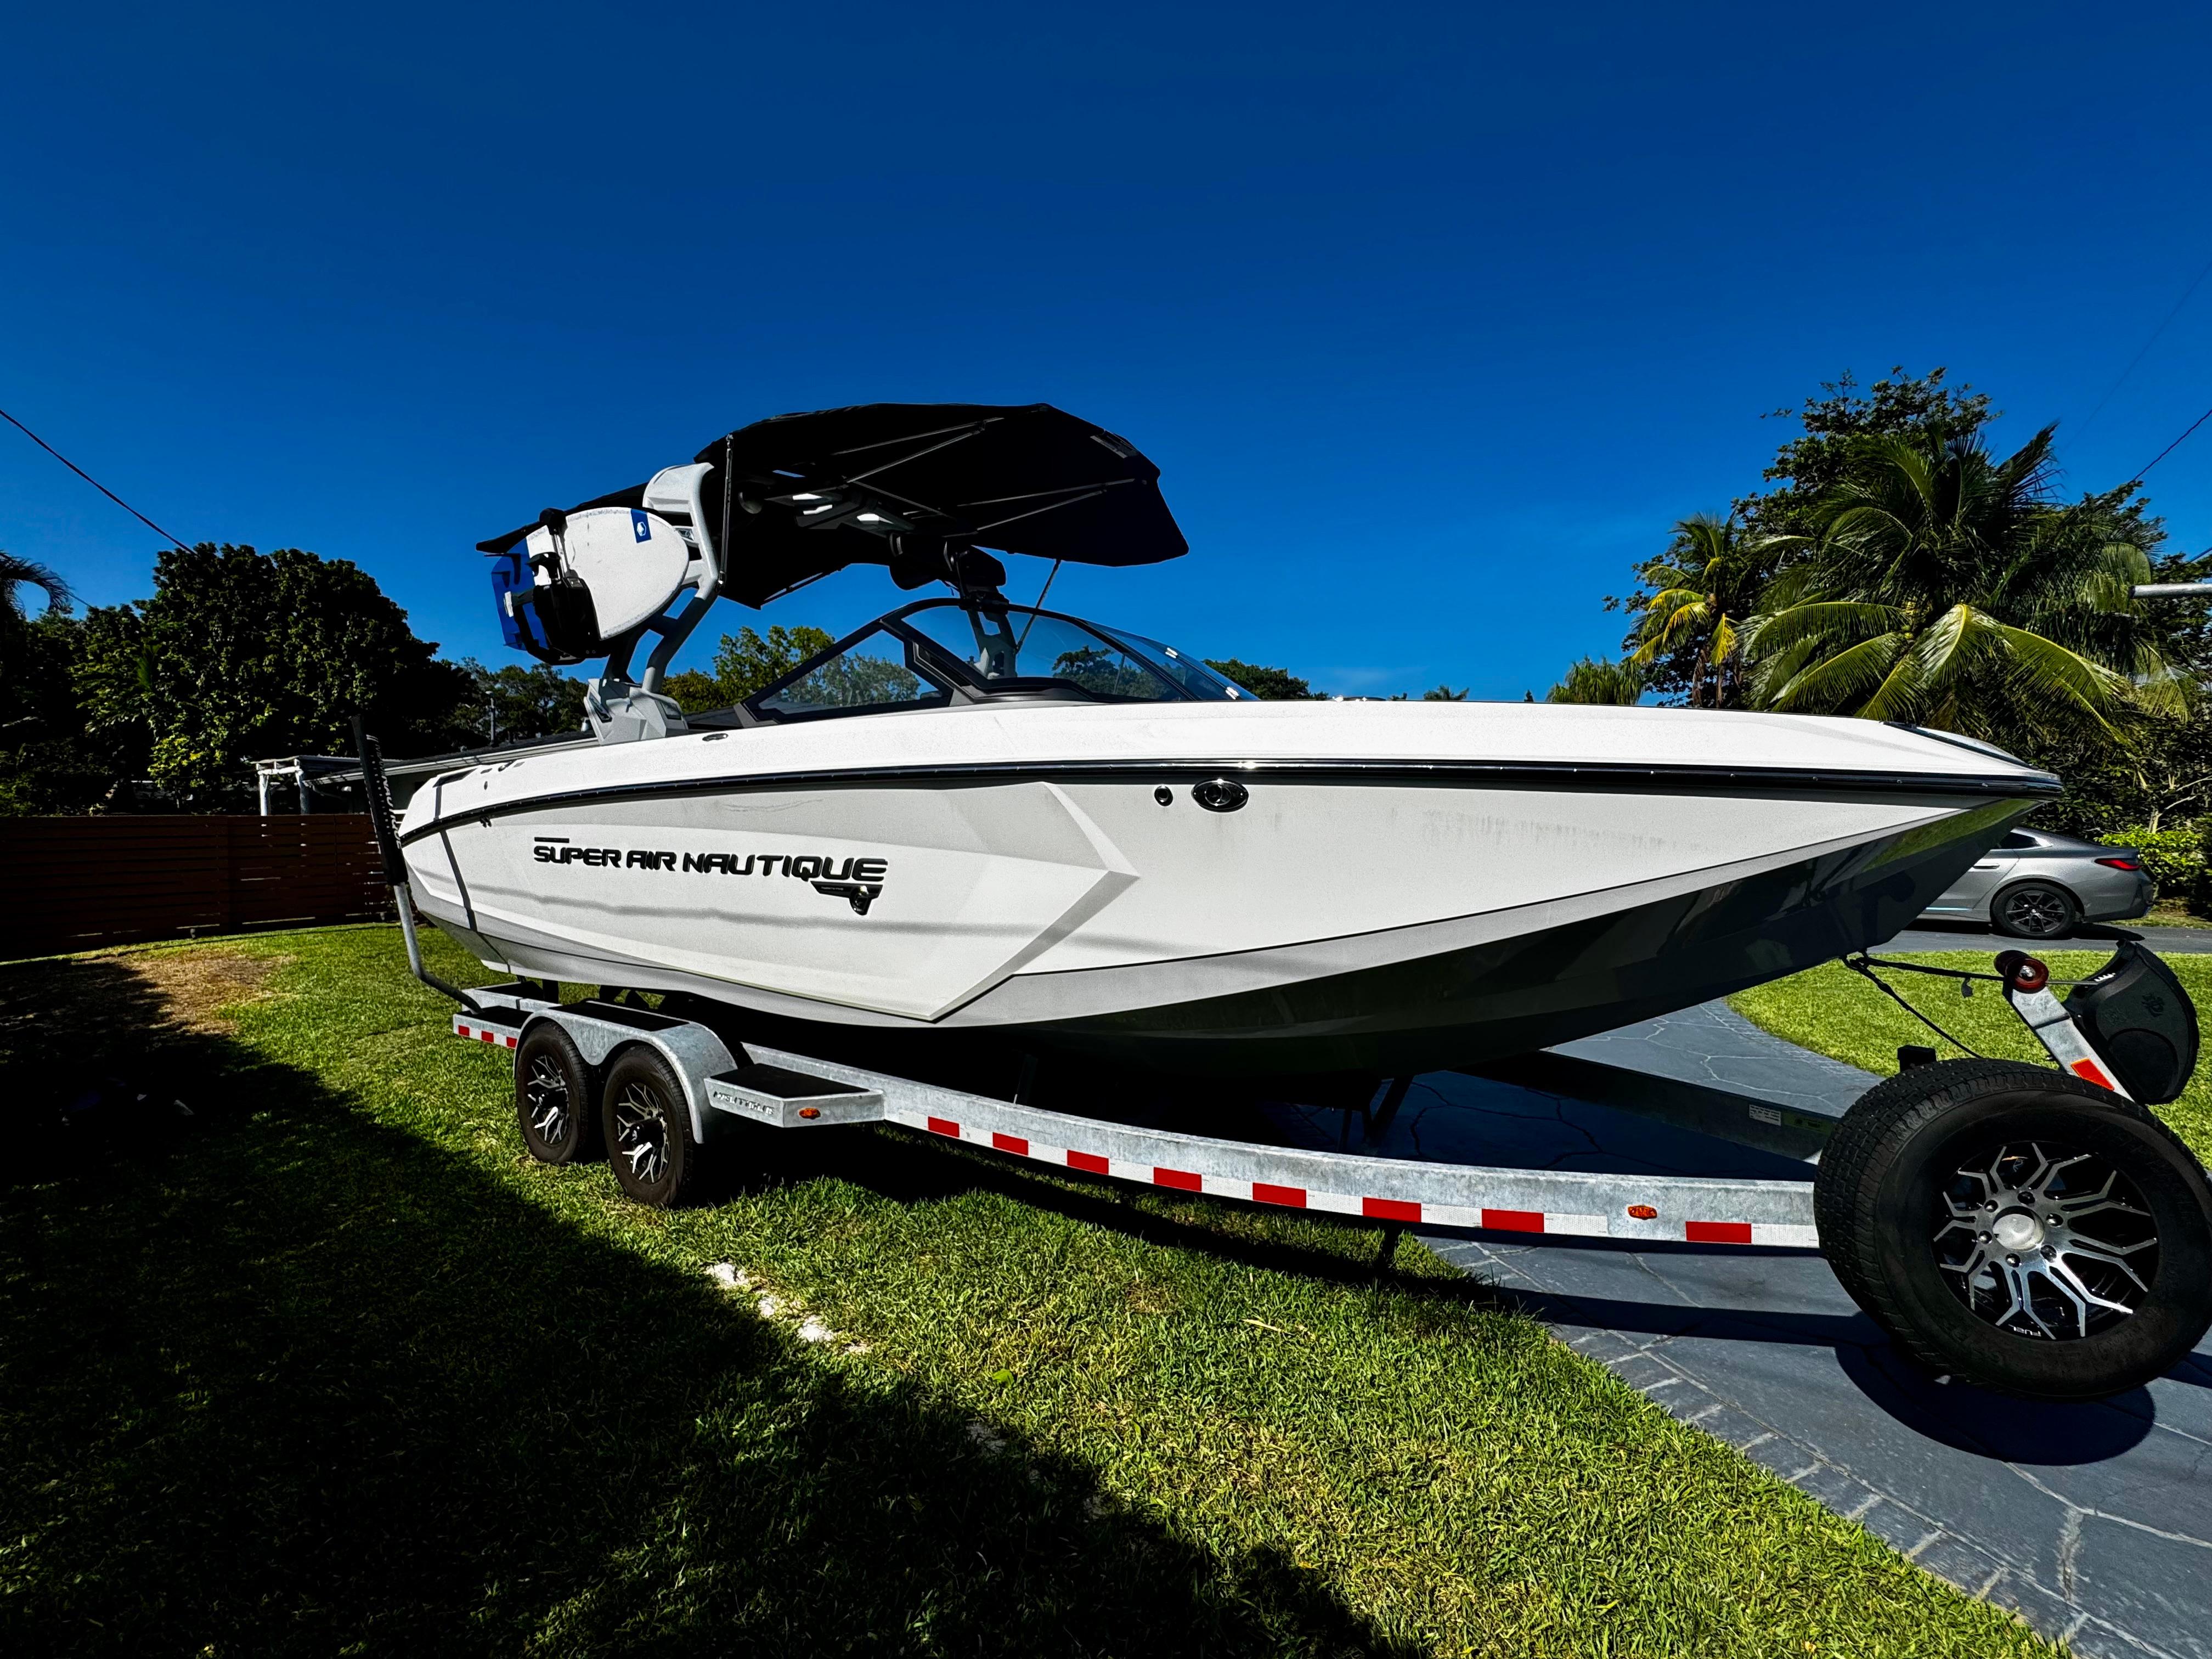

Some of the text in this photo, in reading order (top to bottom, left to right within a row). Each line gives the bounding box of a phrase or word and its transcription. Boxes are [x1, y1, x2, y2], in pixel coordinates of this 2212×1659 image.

[534, 845, 888, 882] SUPER AIR NAUTIQUE
